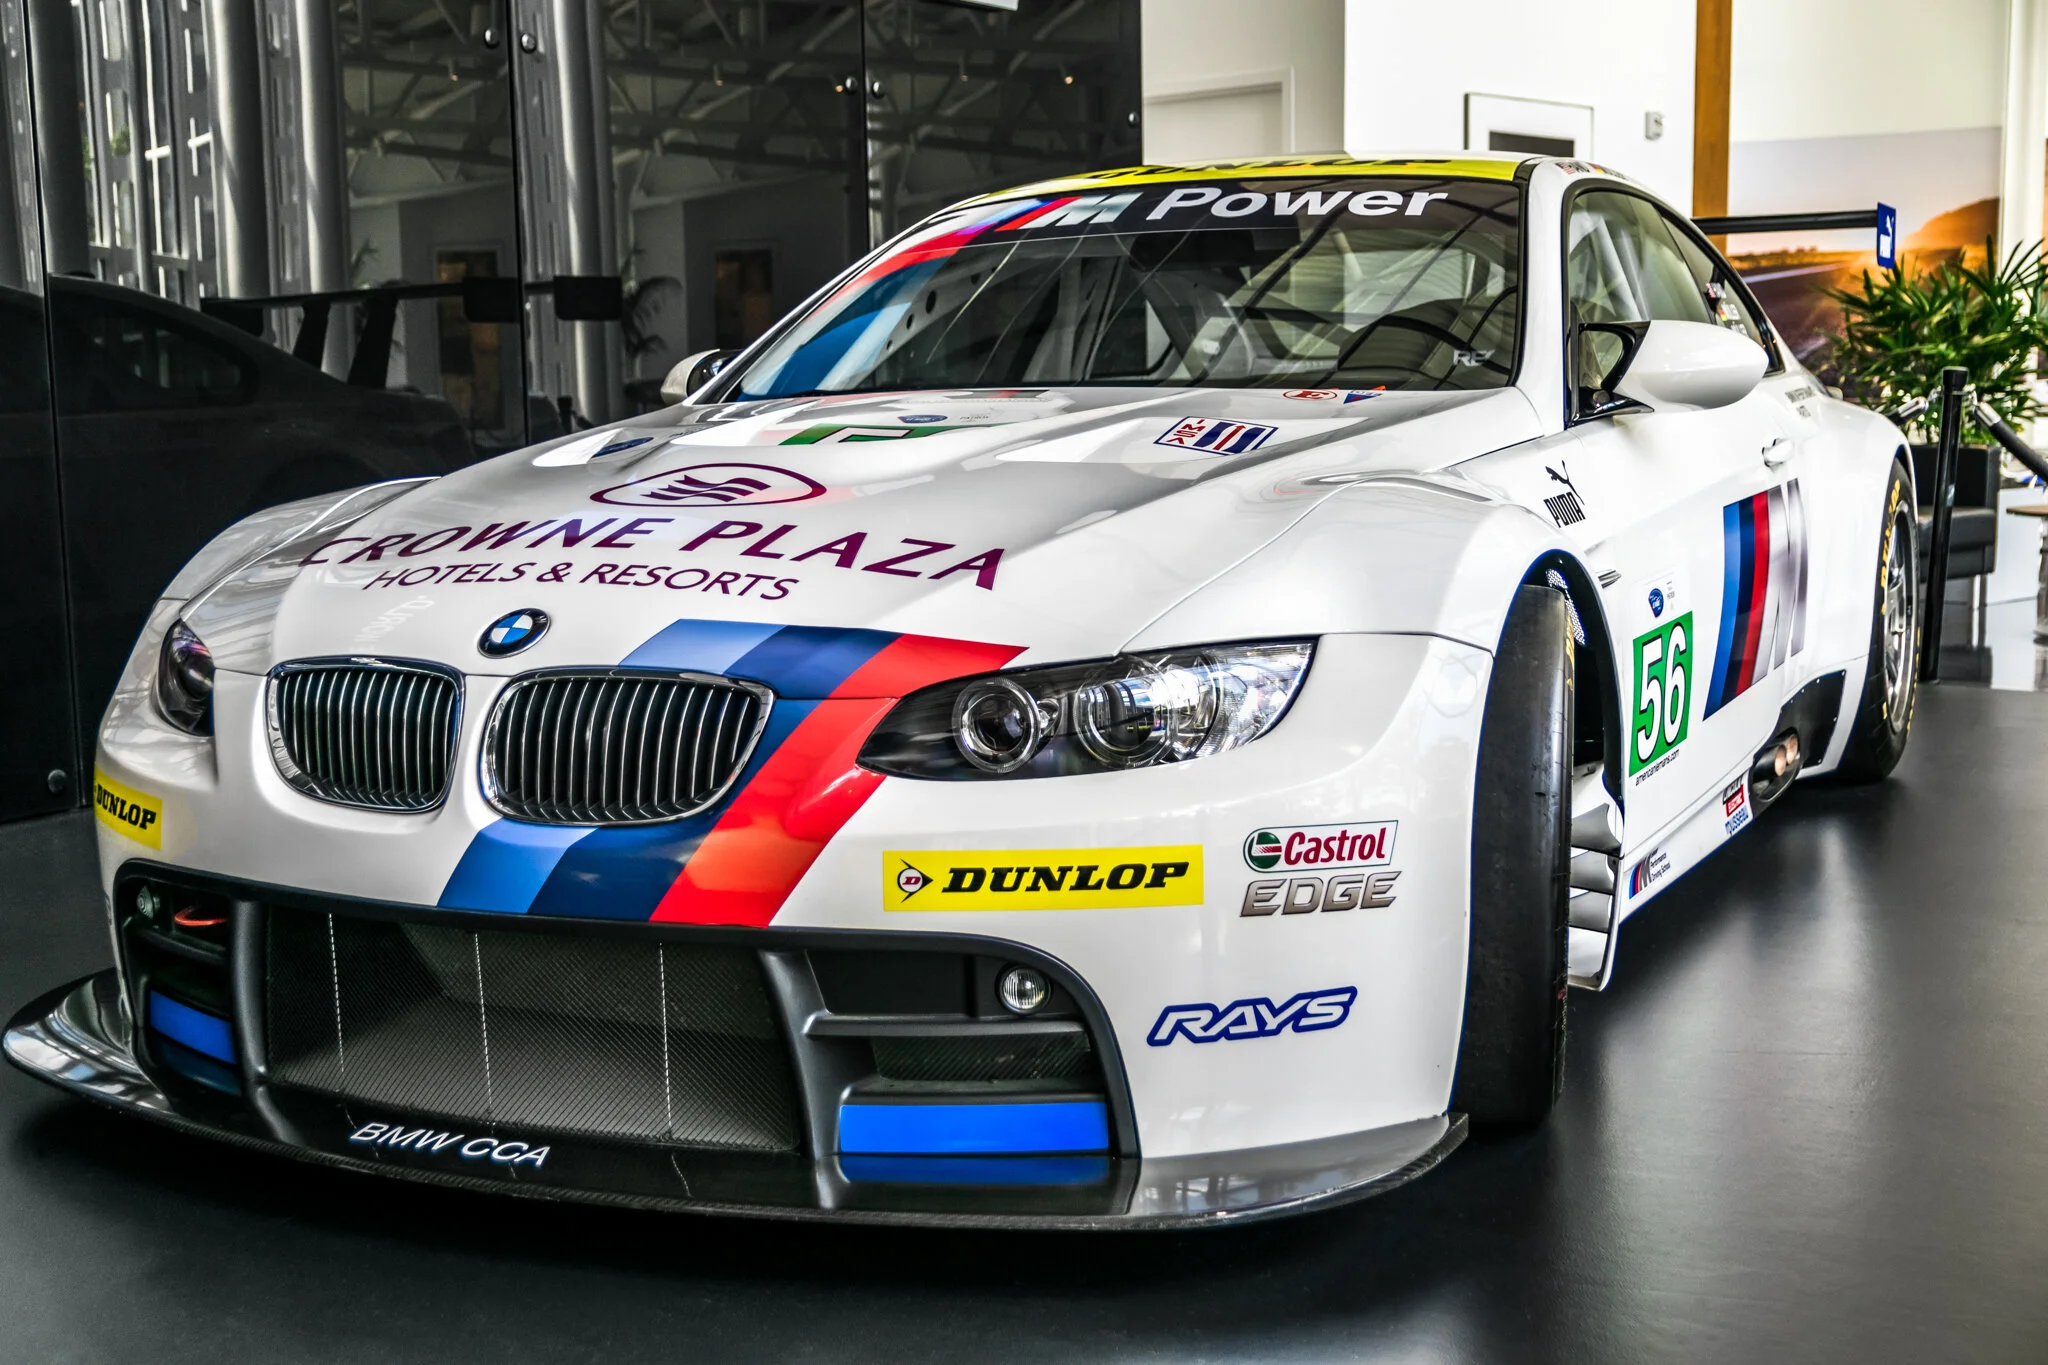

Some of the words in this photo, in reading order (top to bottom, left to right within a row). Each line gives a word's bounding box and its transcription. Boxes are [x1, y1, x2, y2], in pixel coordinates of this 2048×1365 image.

[1146, 186, 1449, 221] Power
[1165, 418, 1206, 446] IMSA
[1543, 491, 1586, 528] PUMA
[299, 517, 675, 568] CROWNE
[678, 519, 1005, 592] PLAZA
[362, 561, 538, 591] HOTELS
[536, 561, 574, 584] &
[579, 563, 800, 601] RESORTS
[1636, 621, 1687, 764] 56
[96, 783, 157, 831] DUNLOP
[1284, 826, 1387, 866] Castrol
[941, 861, 1190, 894] DUNLOP
[1240, 870, 1403, 918] EDGE
[1146, 985, 1358, 1047] RAYS
[350, 1122, 465, 1152] BMW
[461, 1137, 551, 1168] CCA
